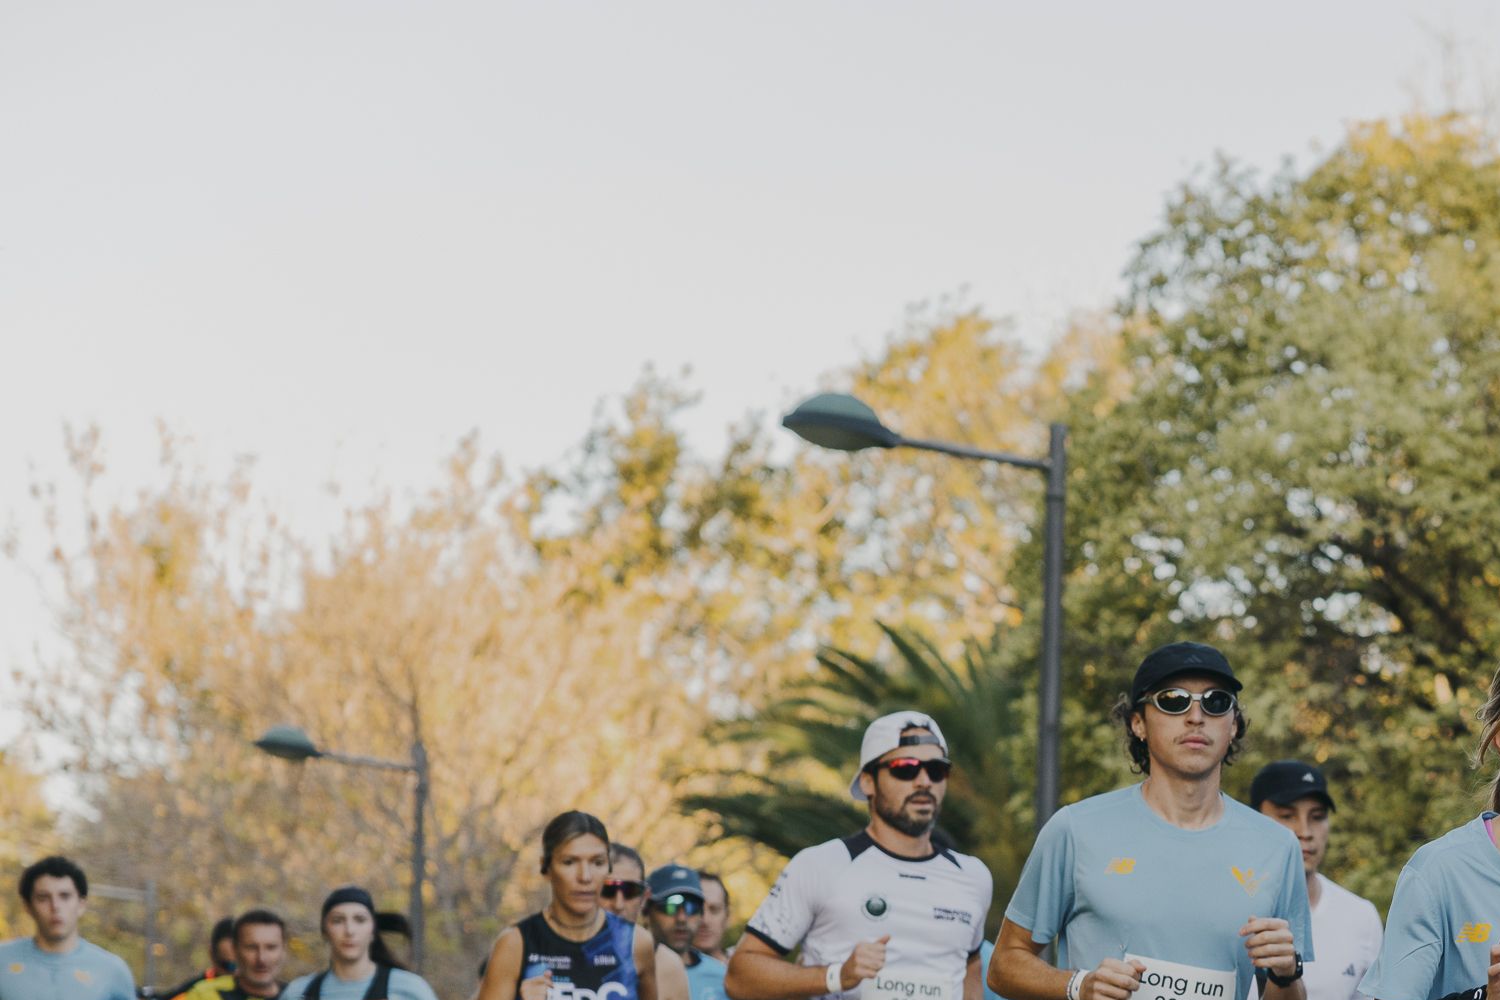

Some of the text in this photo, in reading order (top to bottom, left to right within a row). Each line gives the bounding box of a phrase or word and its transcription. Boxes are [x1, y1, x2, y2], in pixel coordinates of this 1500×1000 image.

[877, 976, 942, 997] Long run
[1194, 981, 1224, 997] run
